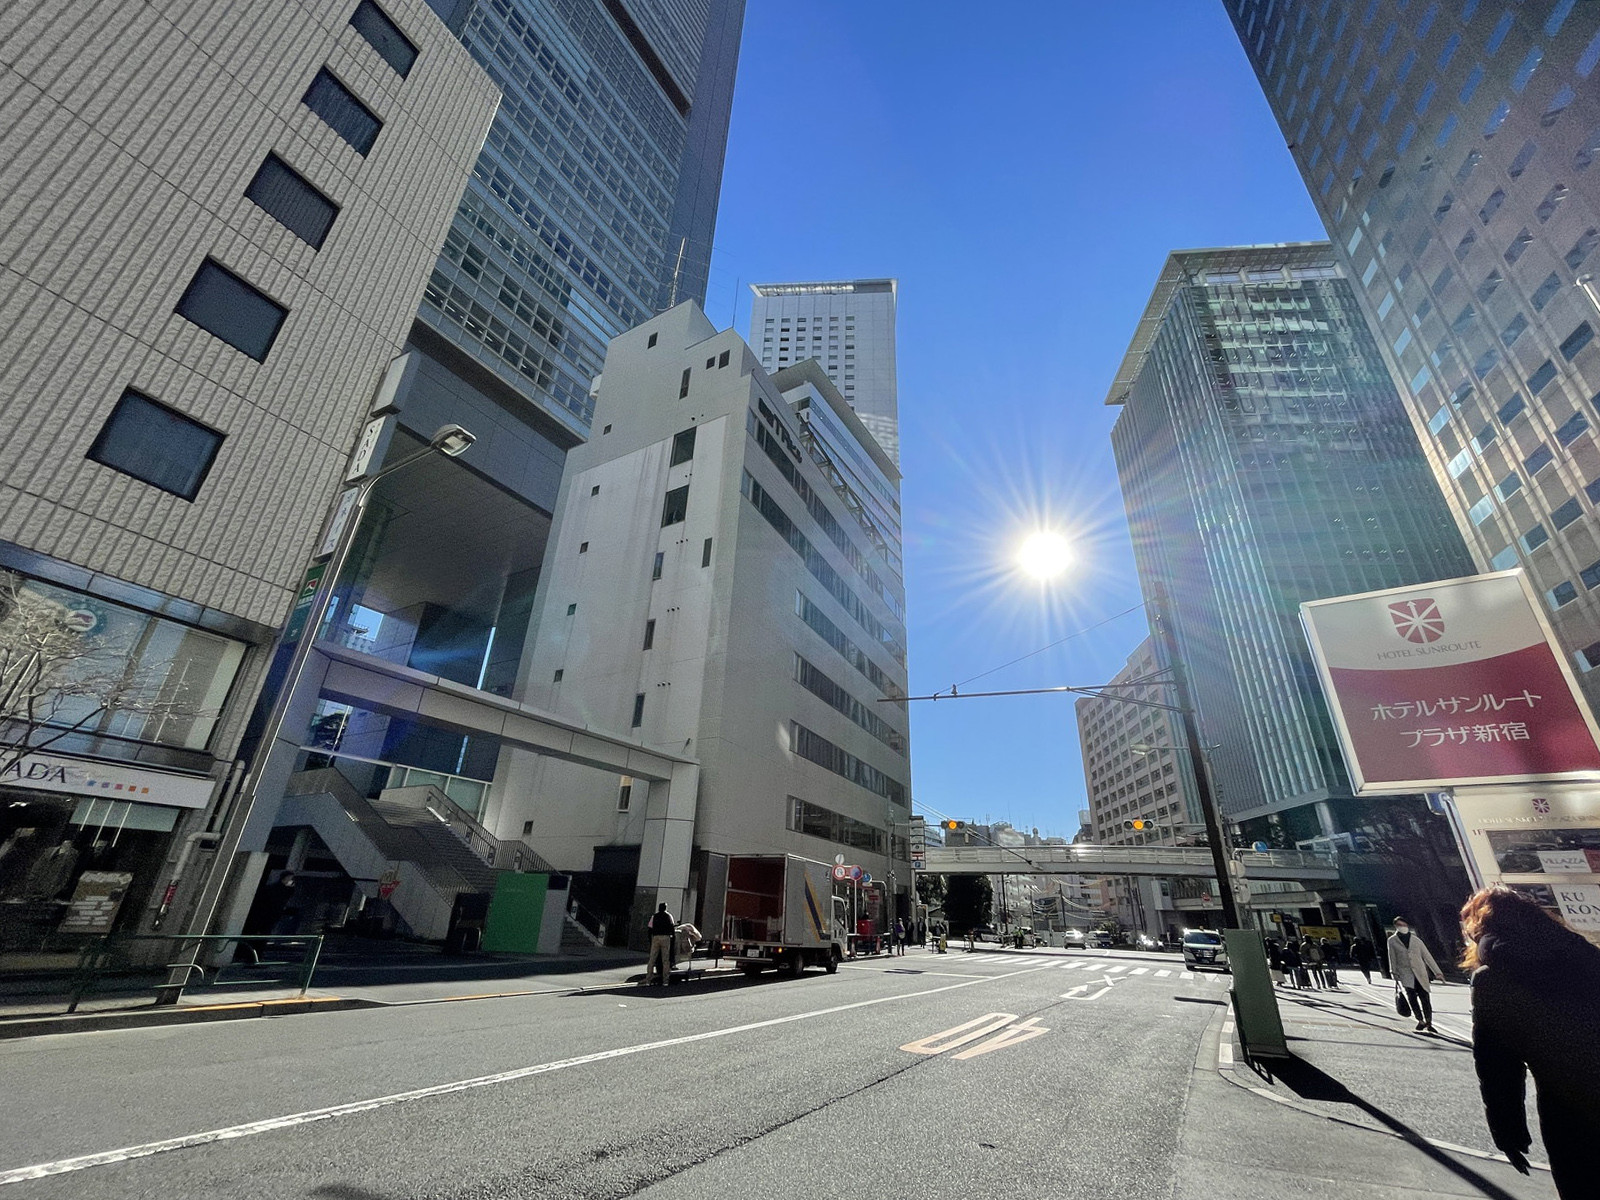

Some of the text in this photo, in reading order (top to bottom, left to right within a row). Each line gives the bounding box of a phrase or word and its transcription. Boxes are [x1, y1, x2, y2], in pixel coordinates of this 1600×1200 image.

[1377, 640, 1482, 661] HOTEL SUNROUTE
[1370, 689, 1542, 721] ホテルサンルート
[1399, 721, 1530, 748] プラザ新宿
[0, 757, 66, 783] ADA
[1560, 891, 1585, 902] KU
